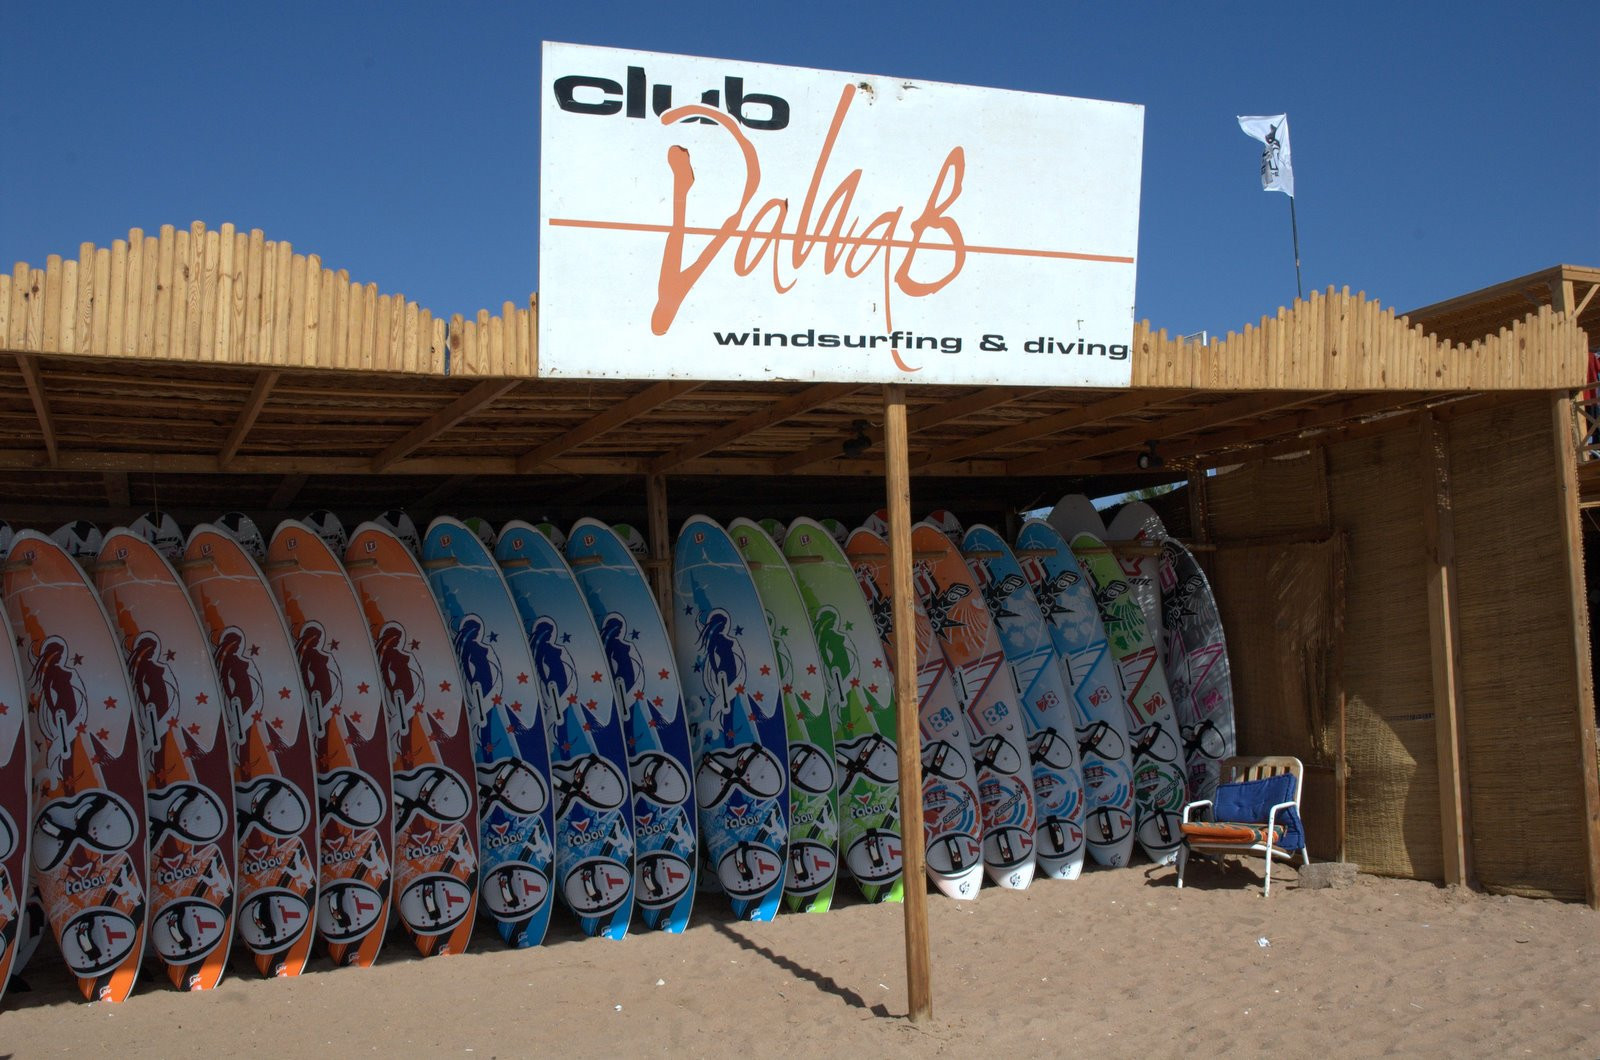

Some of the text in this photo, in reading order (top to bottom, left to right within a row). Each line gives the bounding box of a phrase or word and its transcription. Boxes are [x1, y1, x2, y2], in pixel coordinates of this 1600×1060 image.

[553, 66, 790, 130] club
[713, 328, 1128, 360] windsurfing & diving
[790, 812, 814, 826] bou
[850, 802, 886, 819] tabou
[635, 823, 666, 838] abou
[724, 814, 760, 829] tabou
[486, 832, 523, 849] tabou
[567, 829, 605, 847] tabou
[405, 843, 445, 861] tabou
[242, 856, 283, 875] tabou
[157, 865, 199, 885] tabou
[65, 873, 106, 896] tabou
